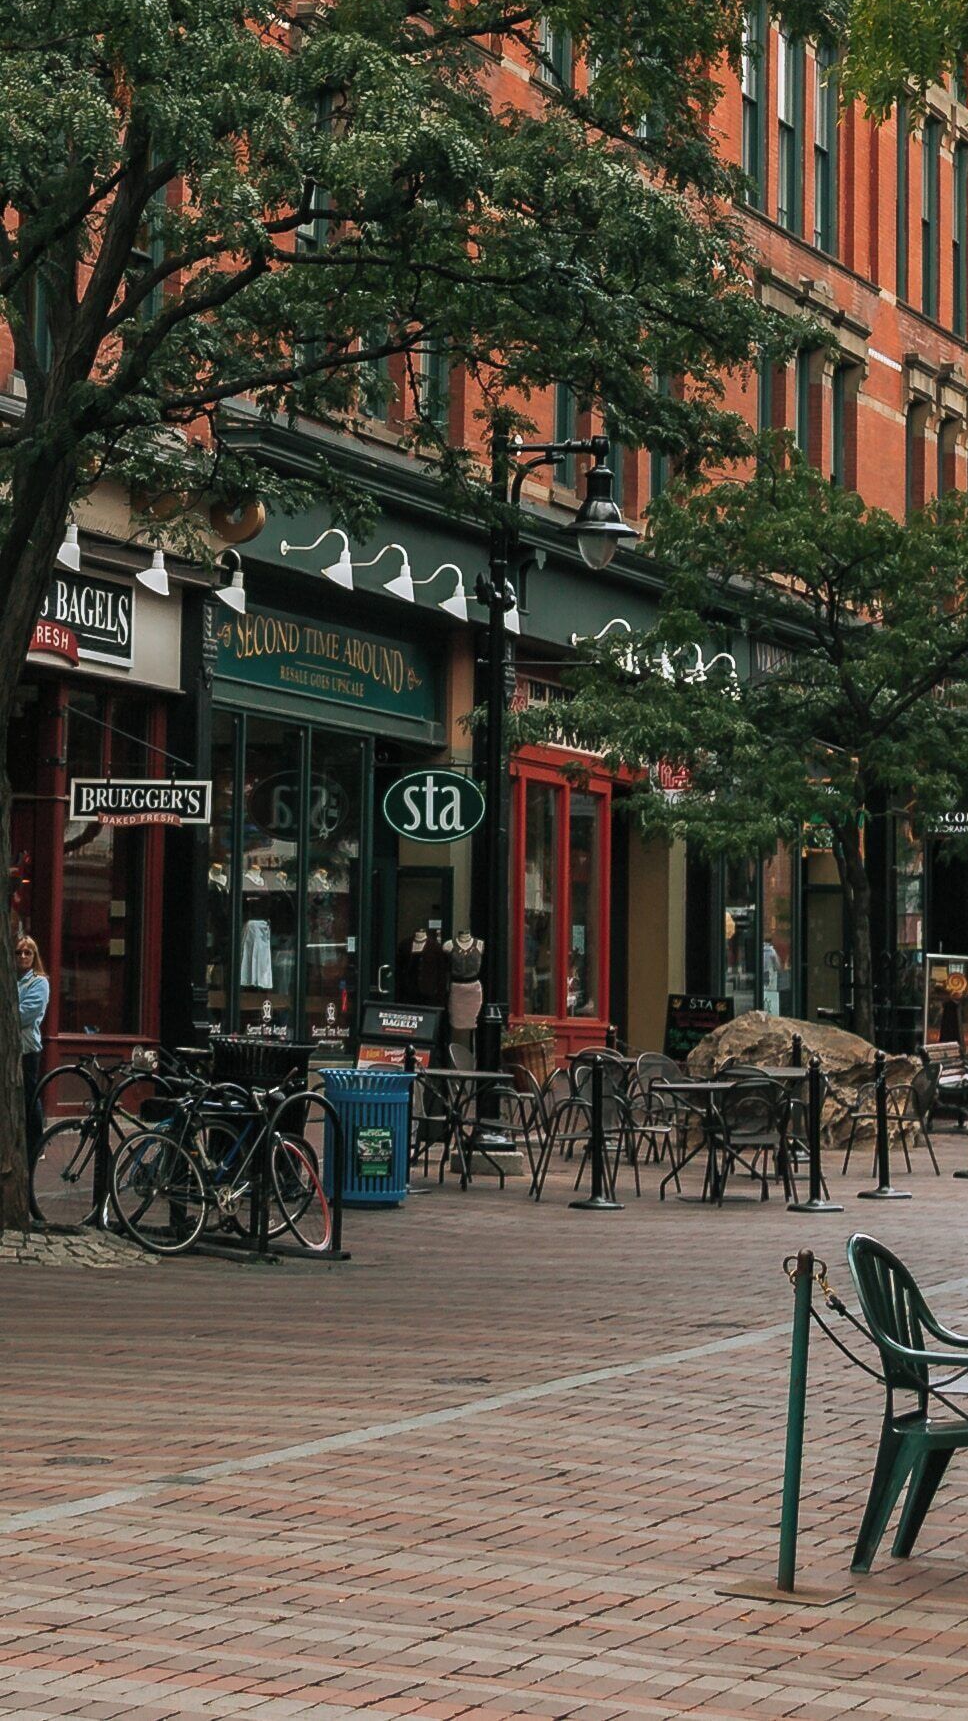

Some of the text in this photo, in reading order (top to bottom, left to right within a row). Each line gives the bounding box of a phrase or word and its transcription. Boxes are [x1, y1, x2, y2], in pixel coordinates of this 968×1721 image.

[55, 580, 129, 646] BAGELS
[36, 625, 69, 650] RESH
[236, 613, 404, 694] SECOND TIME AROUND
[280, 664, 364, 698] RESALE GOES UPSCALE
[80, 787, 200, 814] BRUEGGER'S
[402, 775, 465, 831] sta
[102, 813, 174, 825] BAKED FRESH
[382, 1019, 418, 1029] BAGELS
